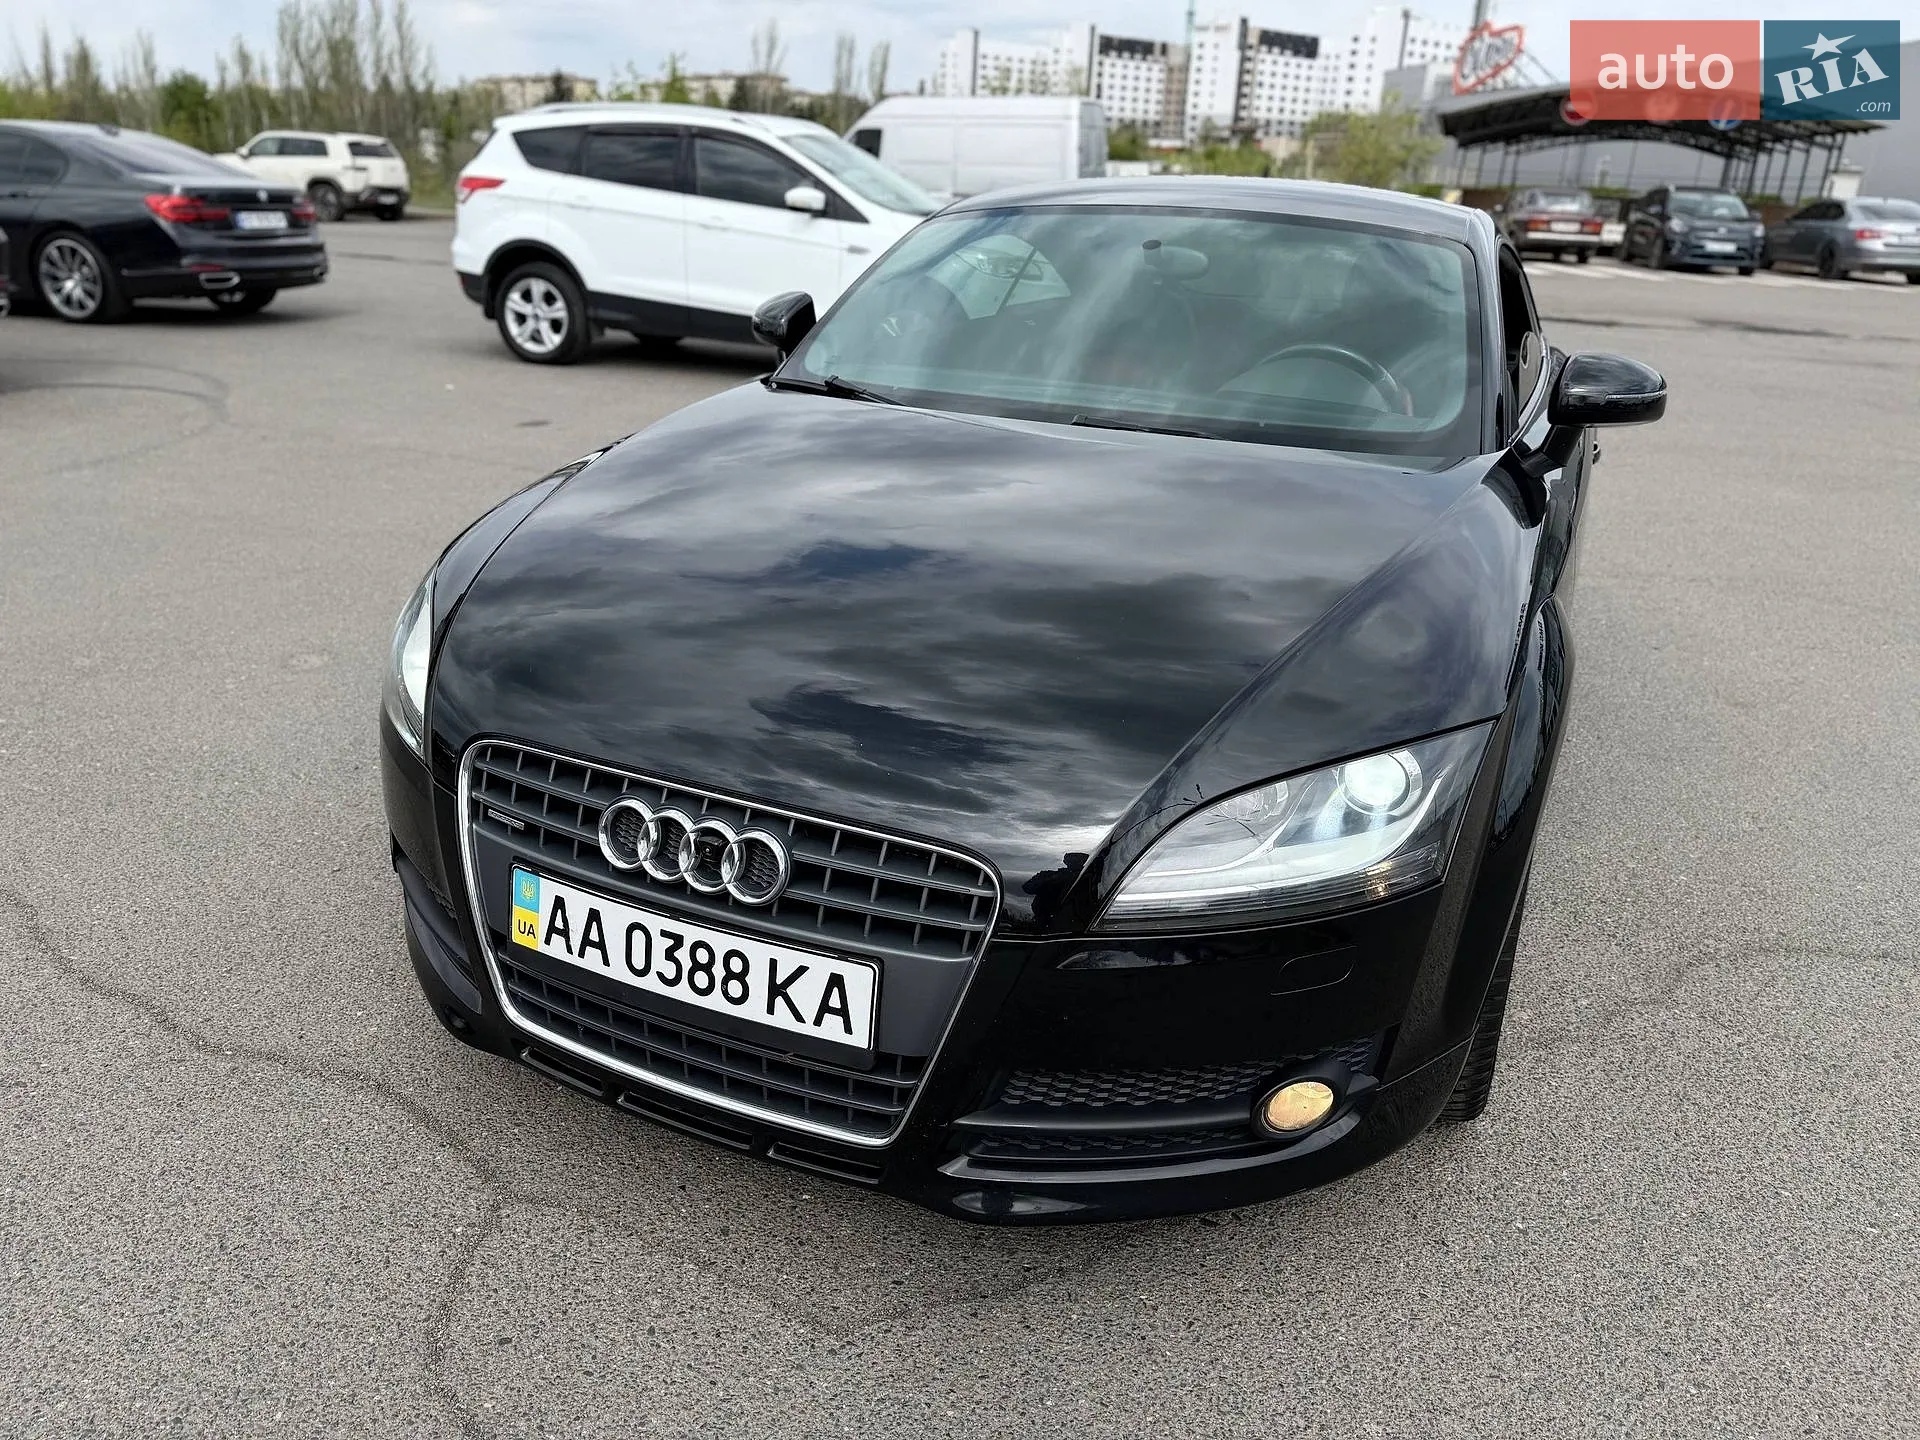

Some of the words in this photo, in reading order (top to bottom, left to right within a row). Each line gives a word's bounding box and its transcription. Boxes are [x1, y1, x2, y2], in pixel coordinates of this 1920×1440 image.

[517, 919, 537, 940] UA
[544, 894, 610, 968] AA
[624, 921, 750, 1006] 0388
[766, 957, 854, 1036] KA
